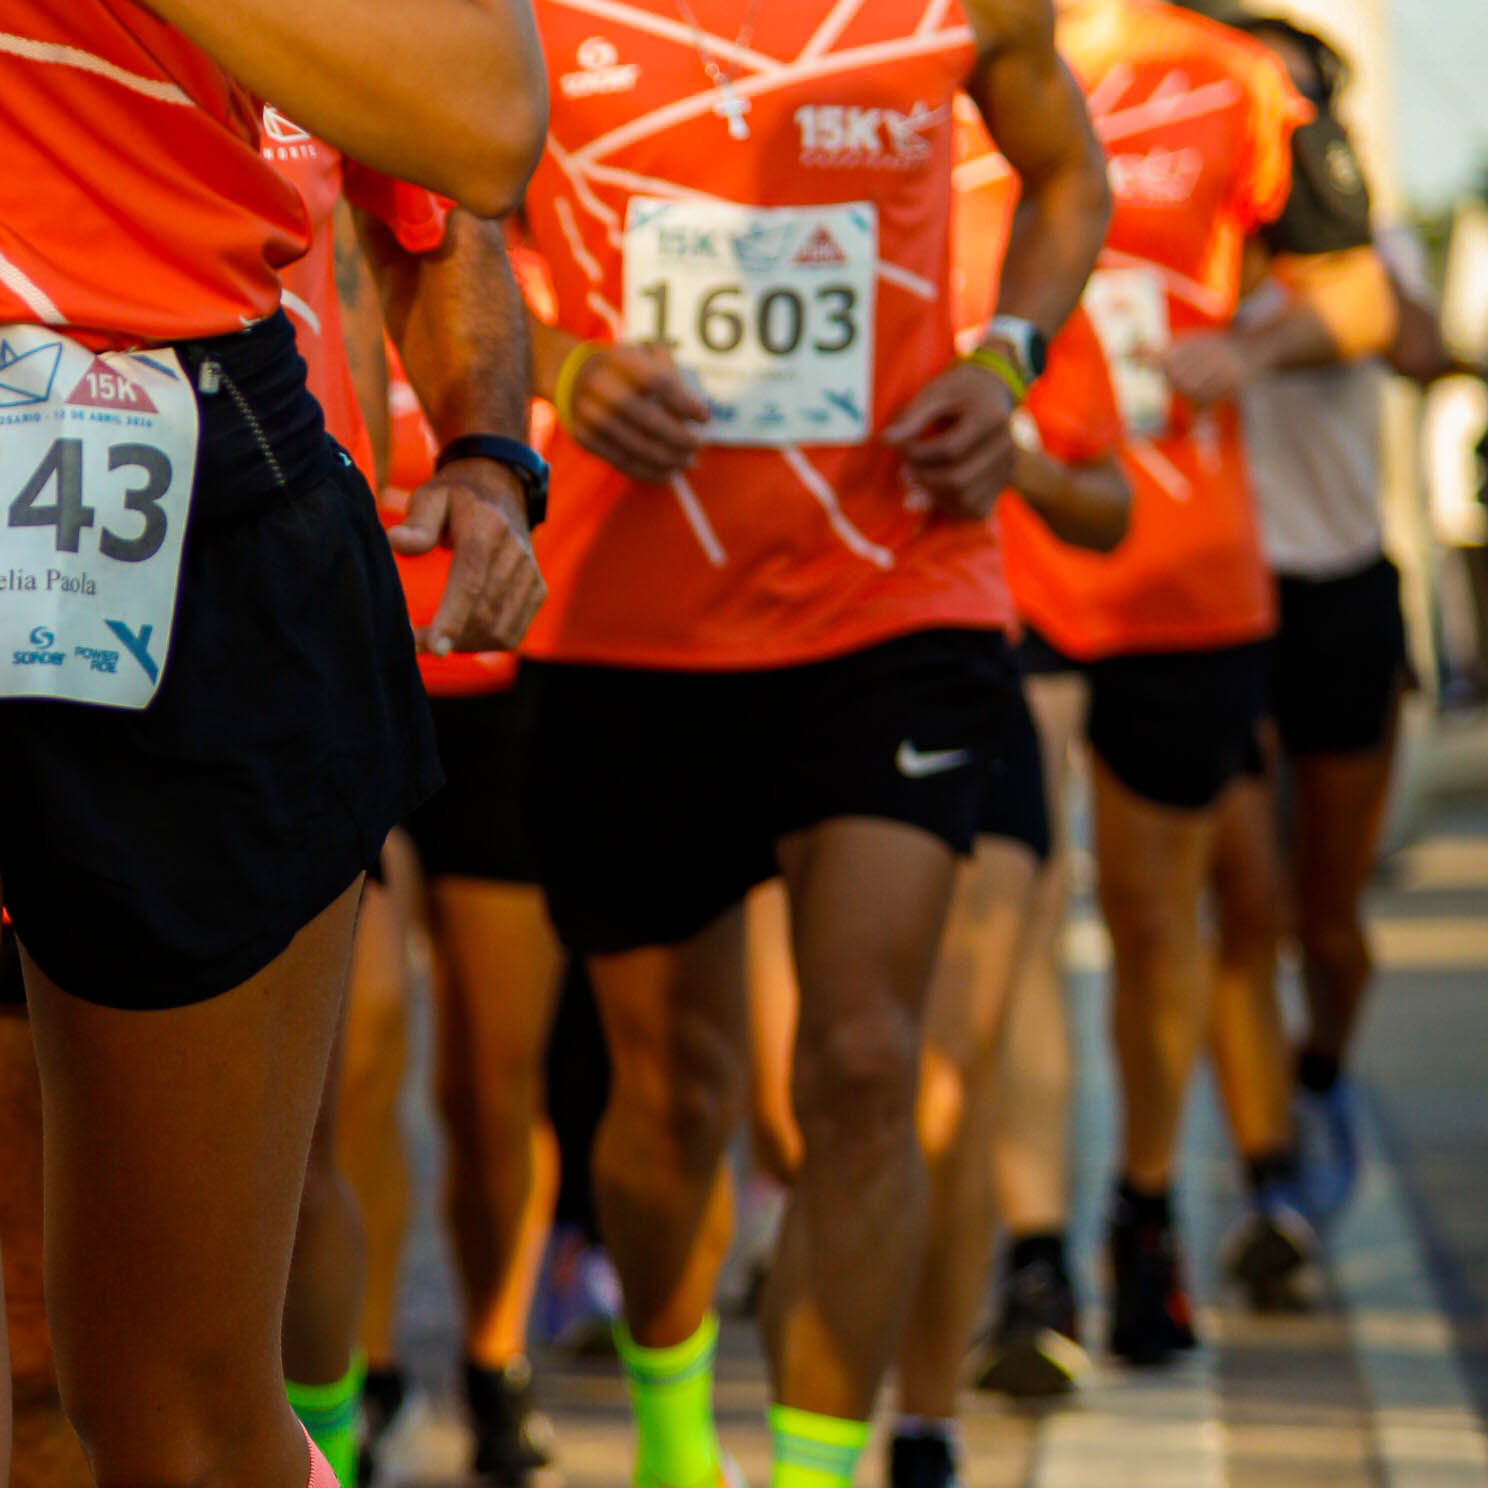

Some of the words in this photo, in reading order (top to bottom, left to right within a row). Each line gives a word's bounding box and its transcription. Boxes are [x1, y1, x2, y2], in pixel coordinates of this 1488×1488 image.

[638, 279, 858, 355] 1603
[86, 372, 138, 403] 15K
[46, 567, 97, 596] Paola
